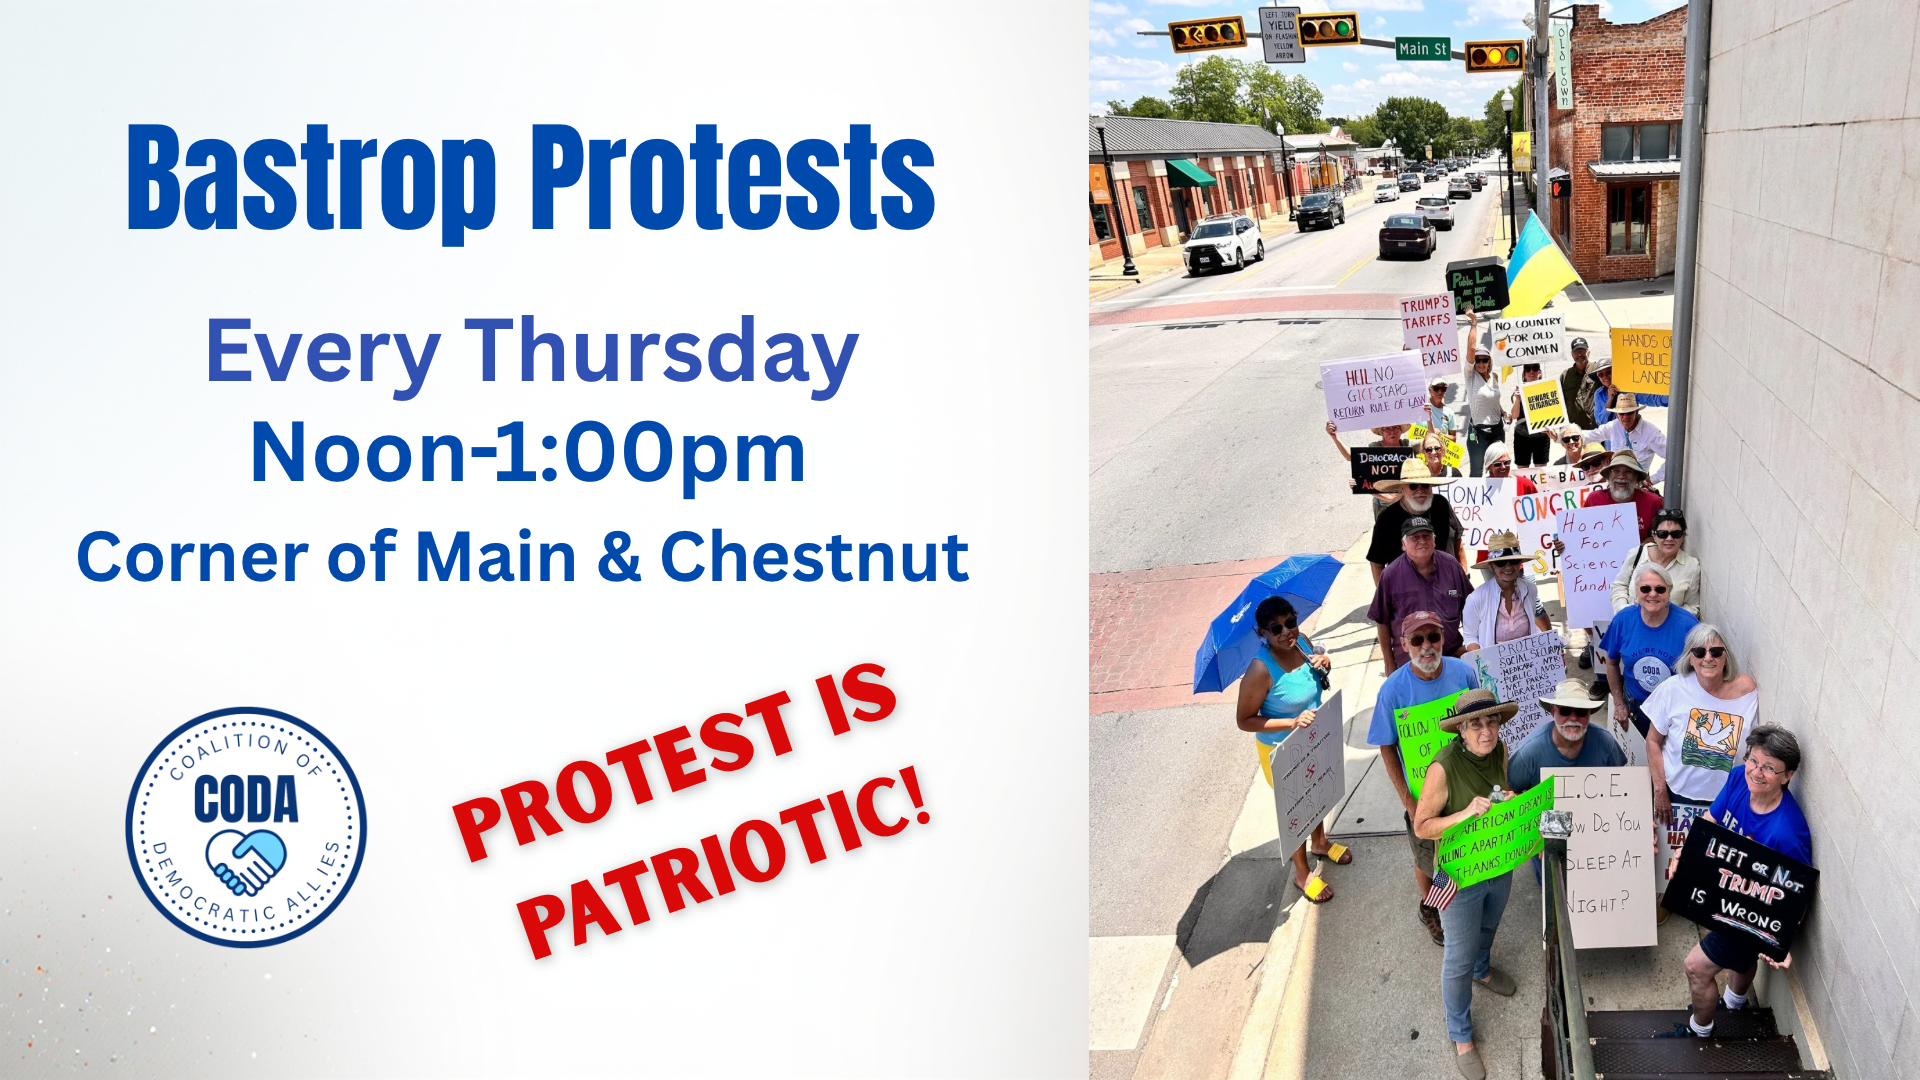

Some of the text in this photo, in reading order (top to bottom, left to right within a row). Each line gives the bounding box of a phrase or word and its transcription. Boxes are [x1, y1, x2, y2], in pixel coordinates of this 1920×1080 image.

[1269, 21, 1294, 30] YIELD
[1400, 42, 1446, 55] Main St
[1453, 272, 1473, 288] Public
[1402, 295, 1450, 313] TRUMP'S
[1474, 295, 1496, 309] Banks
[1403, 313, 1450, 329] TARIFFS
[1495, 317, 1561, 331] NO COUNTRY
[1417, 333, 1443, 347] TAX
[1508, 331, 1553, 344] FOR OLD
[1622, 334, 1658, 348] HANDS
[1506, 343, 1559, 358] CONMEN
[1632, 352, 1669, 367] PUBLIC
[1374, 366, 1393, 382] NO
[1633, 370, 1670, 385] LANDS
[1528, 390, 1558, 404] BEWARE OF
[1529, 398, 1560, 411] OLIGARCHS
[1333, 394, 1426, 419] RETURN RULE OF LAW
[1371, 465, 1398, 475] NOT
[1559, 470, 1586, 483] BAD
[1438, 484, 1493, 506] HONK
[1453, 505, 1482, 522] FOR
[1581, 537, 1611, 549] For
[1565, 555, 1624, 569] Scienc
[1500, 654, 1529, 668] SOCIAL
[1631, 648, 1673, 660] WE'RE NOT
[1504, 663, 1560, 684] PUBLIC LANDS
[1642, 666, 1660, 675] CODA
[1526, 674, 1548, 685] PARKS
[1507, 680, 1551, 699] LIBRARIES
[1520, 712, 1542, 724] VOTER
[1399, 720, 1429, 738] FOLLOW
[1516, 723, 1534, 733] DATA
[1420, 743, 1431, 757] OF
[1554, 774, 1627, 799] I.C.E.
[1460, 809, 1514, 837] AMERICAN
[1545, 788, 1551, 801] IS
[1470, 834, 1504, 855] APART
[1506, 828, 1516, 843] AT
[1455, 839, 1533, 880] THANKS DONALD
[1567, 849, 1641, 871] SLEEP AT
[1705, 837, 1748, 868] LEFT
[1718, 867, 1784, 905] TRUMP
[1567, 890, 1629, 913] NIGHT?
[1691, 887, 1782, 932] IS WRONG
